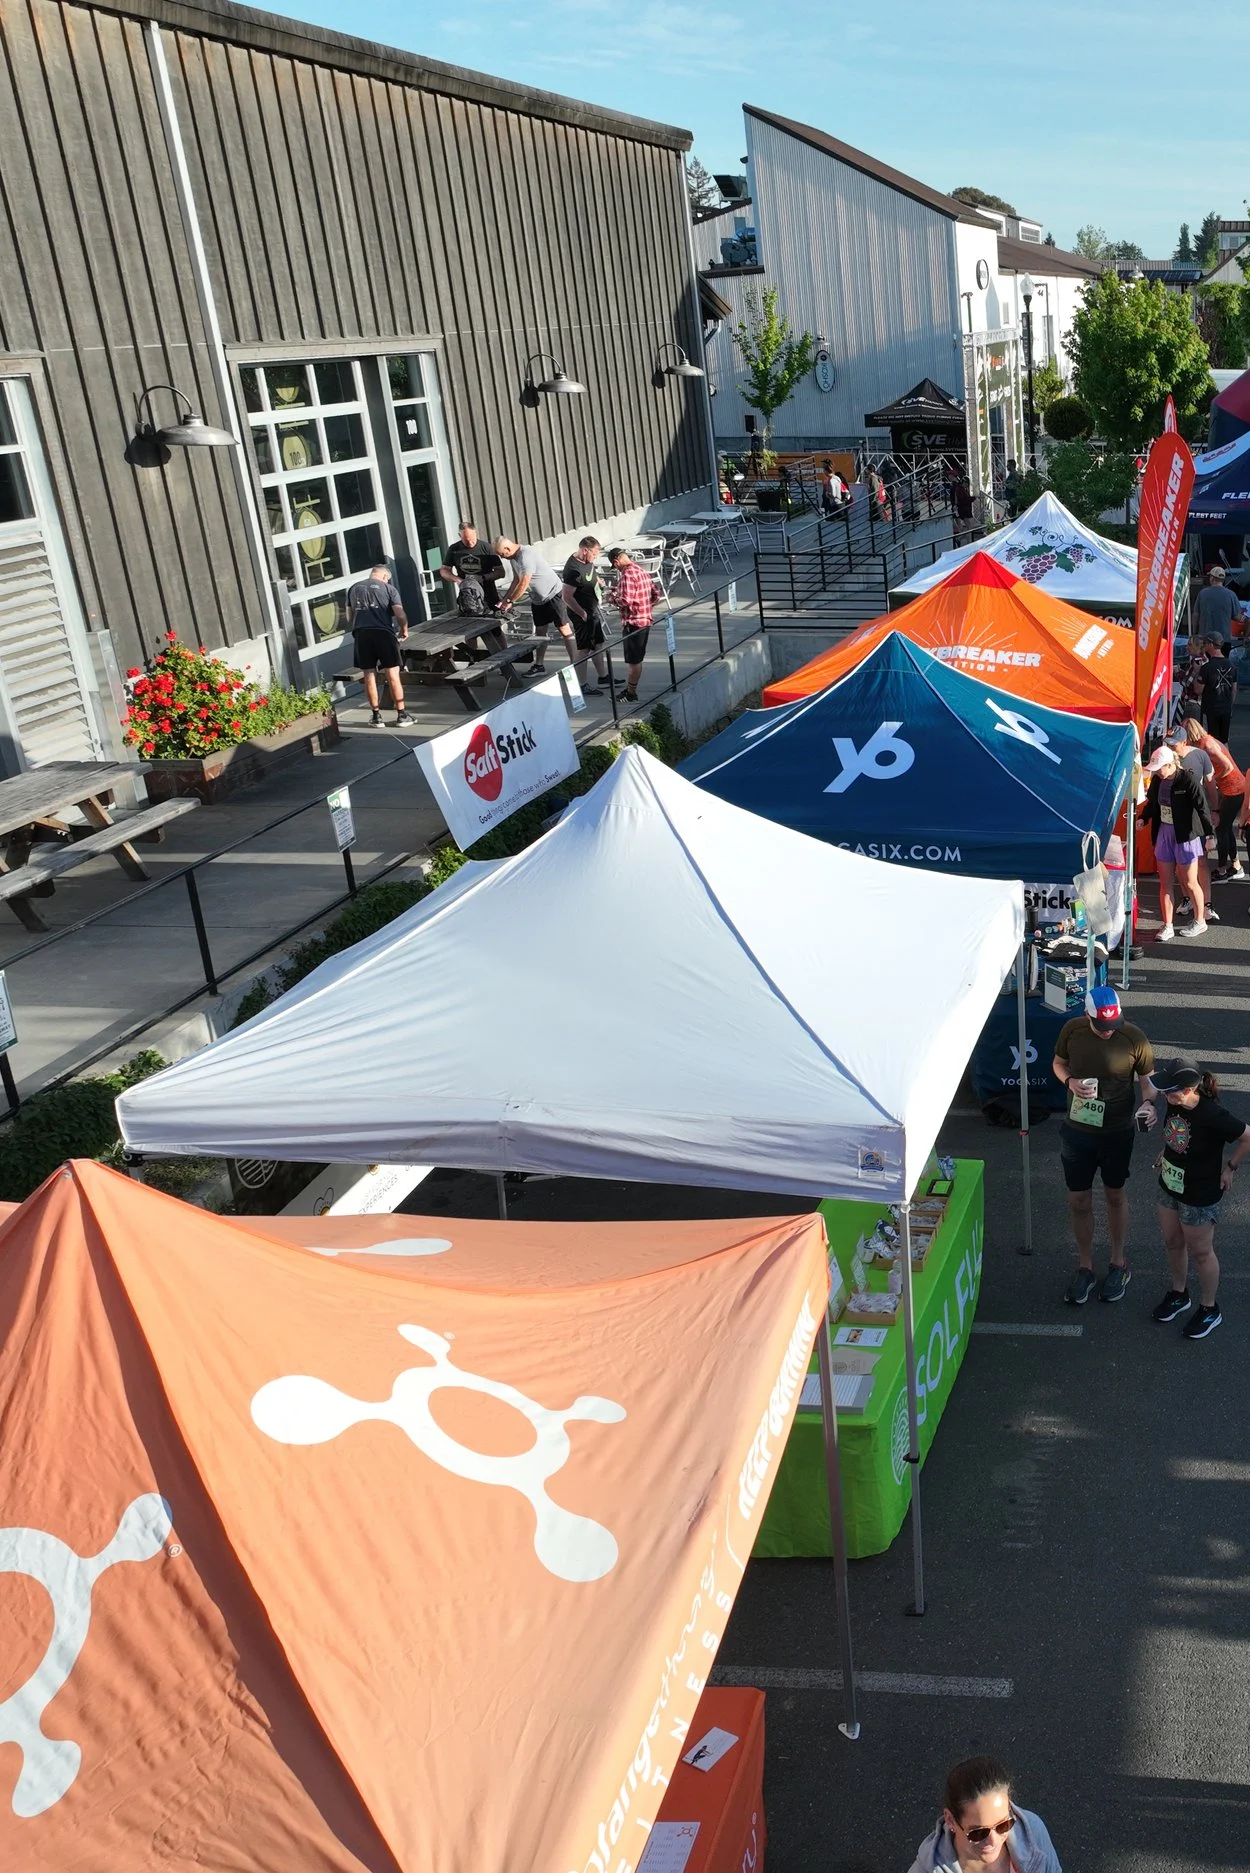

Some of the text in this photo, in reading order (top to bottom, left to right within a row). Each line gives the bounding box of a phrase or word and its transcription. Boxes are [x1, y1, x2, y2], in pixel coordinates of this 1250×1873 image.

[821, 363, 830, 389] KOSHO
[911, 434, 947, 446] SVE
[1138, 451, 1185, 651] BONKBREAKER
[1157, 519, 1180, 614] NUTRITION
[1083, 1100, 1104, 1113] 480
[1166, 1166, 1183, 1181] 479
